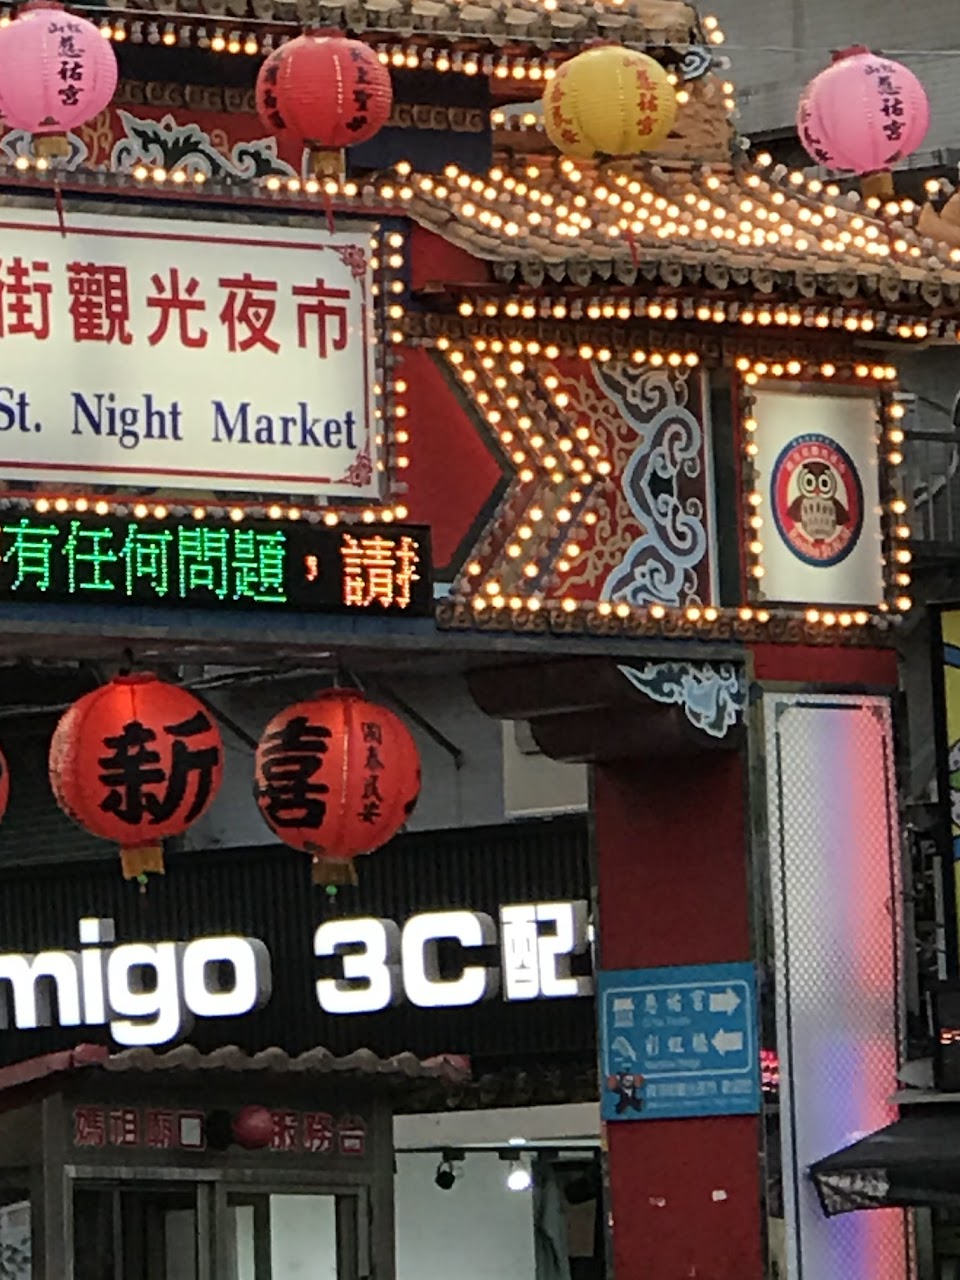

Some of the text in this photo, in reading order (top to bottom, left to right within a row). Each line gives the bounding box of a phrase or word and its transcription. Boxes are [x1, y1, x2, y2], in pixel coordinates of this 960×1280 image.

[71, 392, 184, 451] Night
[210, 399, 359, 451] Market
[98, 710, 220, 825] 新
[254, 716, 333, 830] 喜
[313, 900, 595, 1016] 3C配
